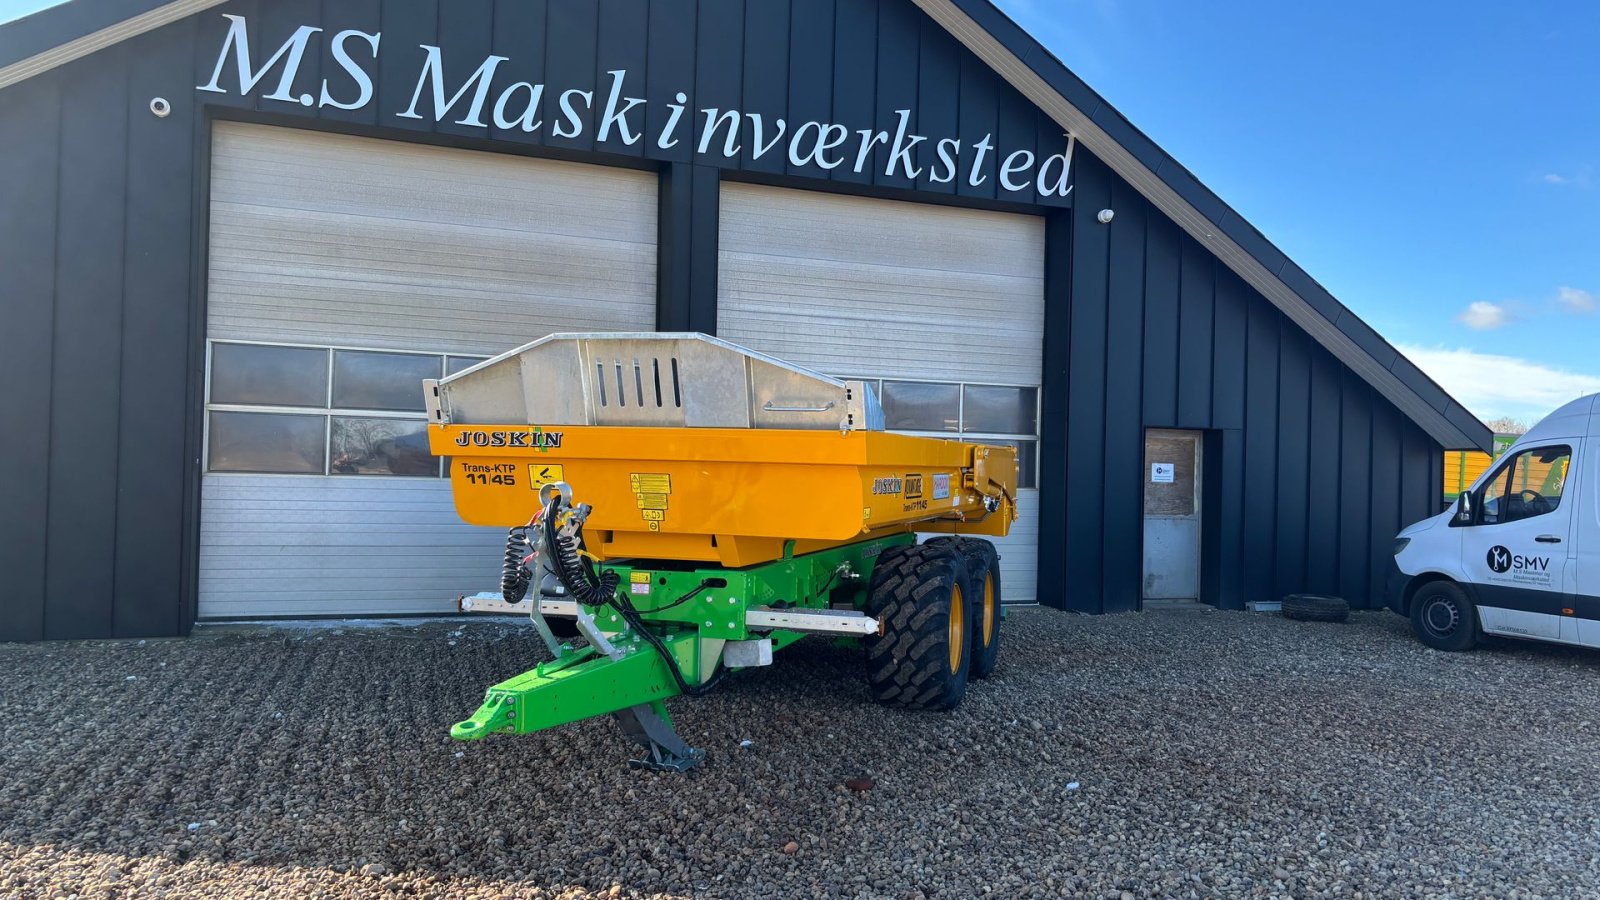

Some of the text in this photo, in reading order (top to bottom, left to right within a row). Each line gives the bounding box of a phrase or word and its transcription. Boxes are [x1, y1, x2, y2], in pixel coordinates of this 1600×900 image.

[196, 13, 1077, 198] M.S Maskinværksted
[455, 431, 564, 447] JOSKIN
[462, 463, 516, 473] Trans-KTP
[872, 478, 902, 495] JOSKIN
[1513, 555, 1550, 571] SMV
